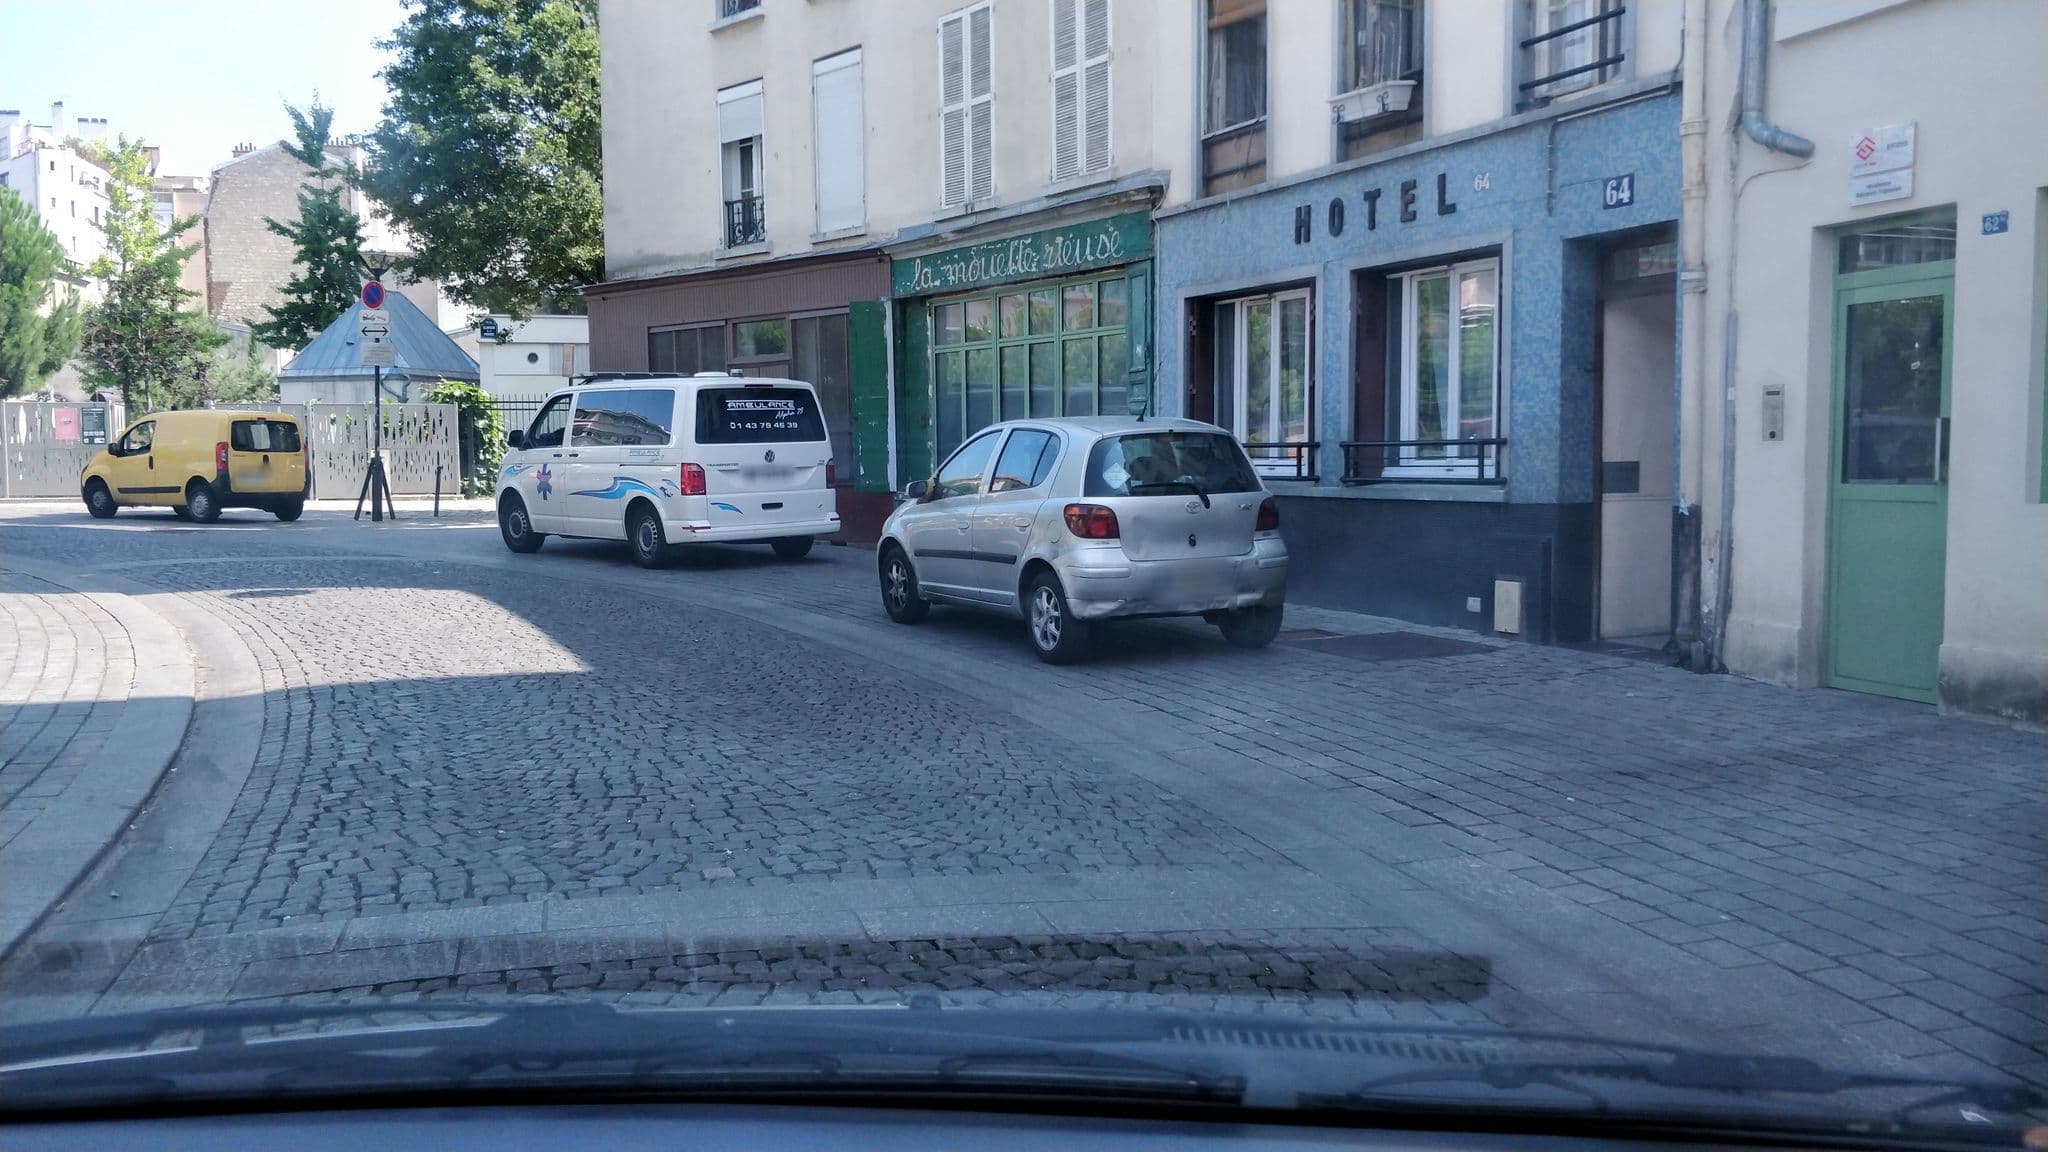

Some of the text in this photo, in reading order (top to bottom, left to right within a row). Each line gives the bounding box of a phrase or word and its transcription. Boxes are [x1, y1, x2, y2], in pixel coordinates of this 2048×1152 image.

[1475, 172, 1489, 191] 64
[1606, 176, 1631, 205] 64
[1294, 173, 1457, 245] HOTEL
[911, 230, 1124, 290] la mouette rieuse
[730, 421, 742, 430] 01
[745, 421, 758, 430] 43
